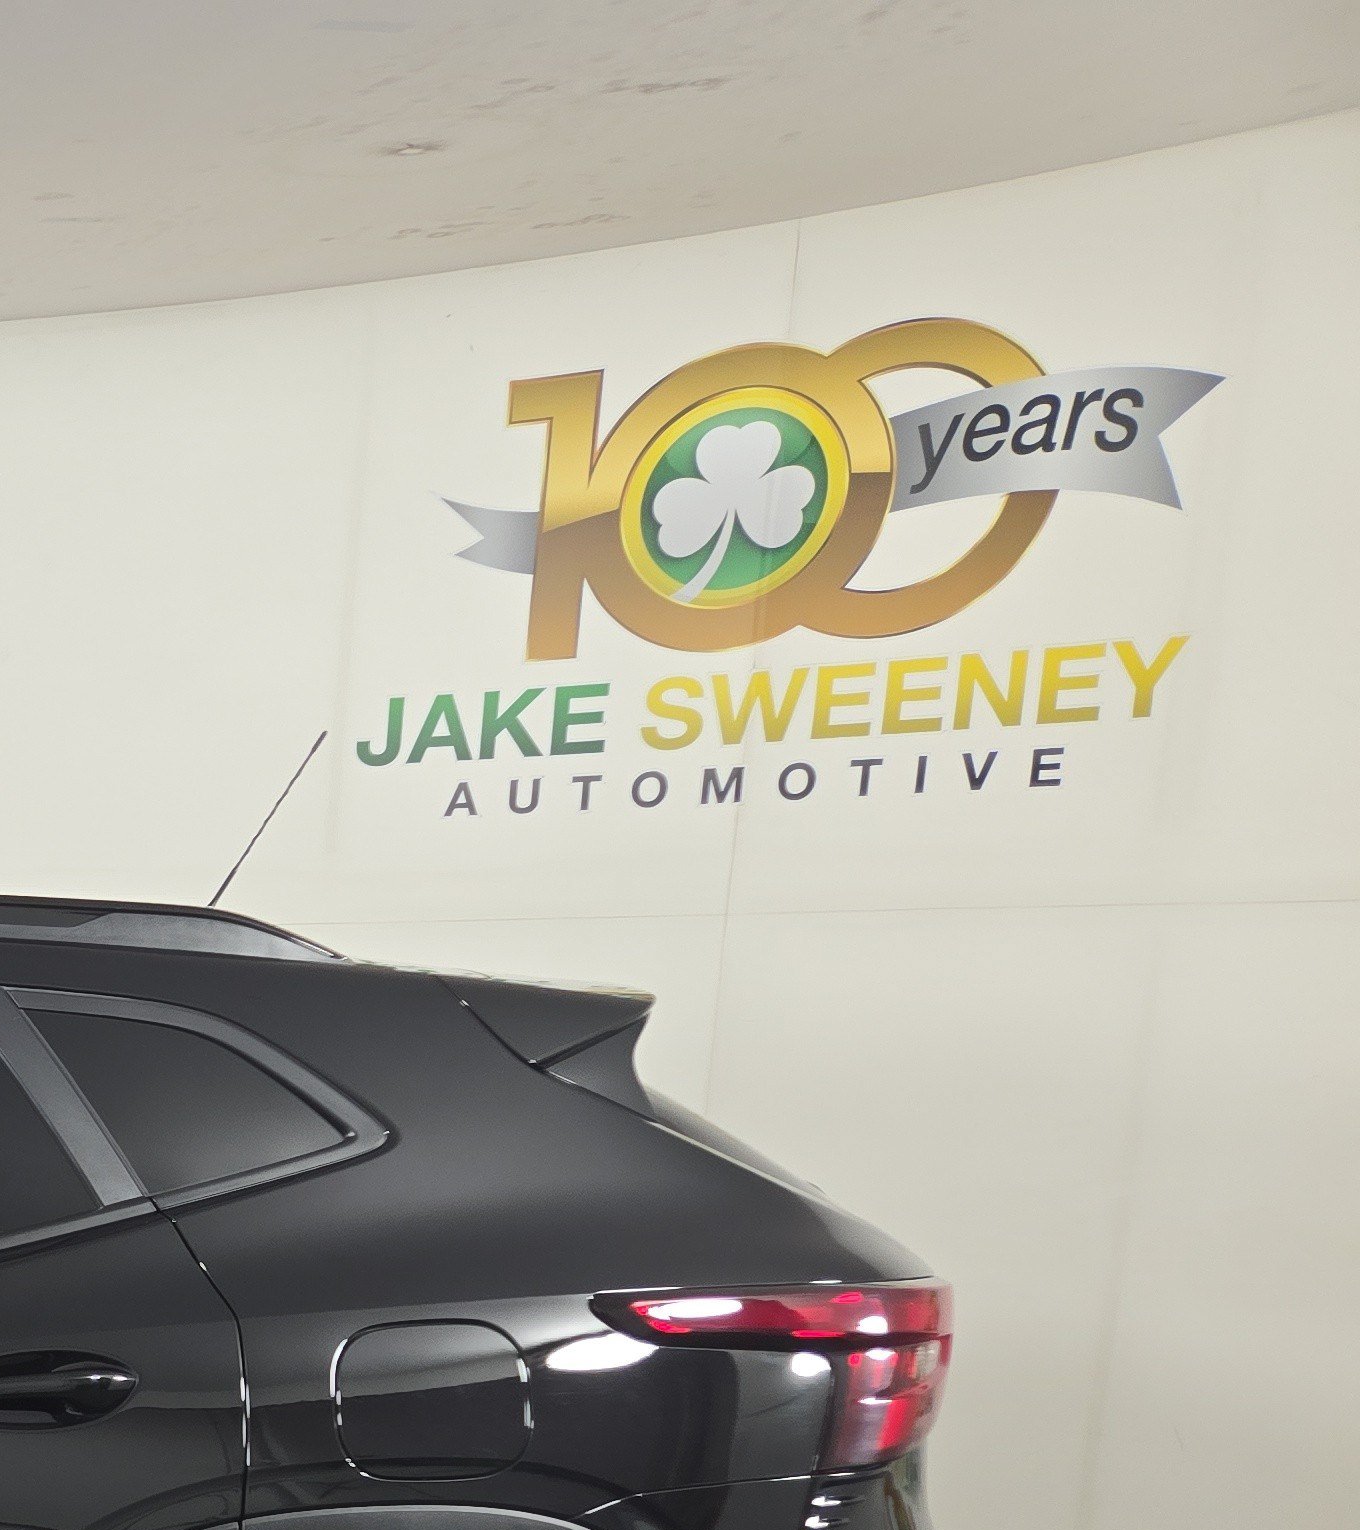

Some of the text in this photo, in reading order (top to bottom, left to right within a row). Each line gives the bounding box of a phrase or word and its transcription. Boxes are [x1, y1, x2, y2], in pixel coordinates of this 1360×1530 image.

[506, 317, 1061, 661] 100
[910, 388, 1144, 494] years
[356, 635, 1191, 767] JAKE SWEENEY
[444, 746, 1065, 817] AUTOMOTIVE
